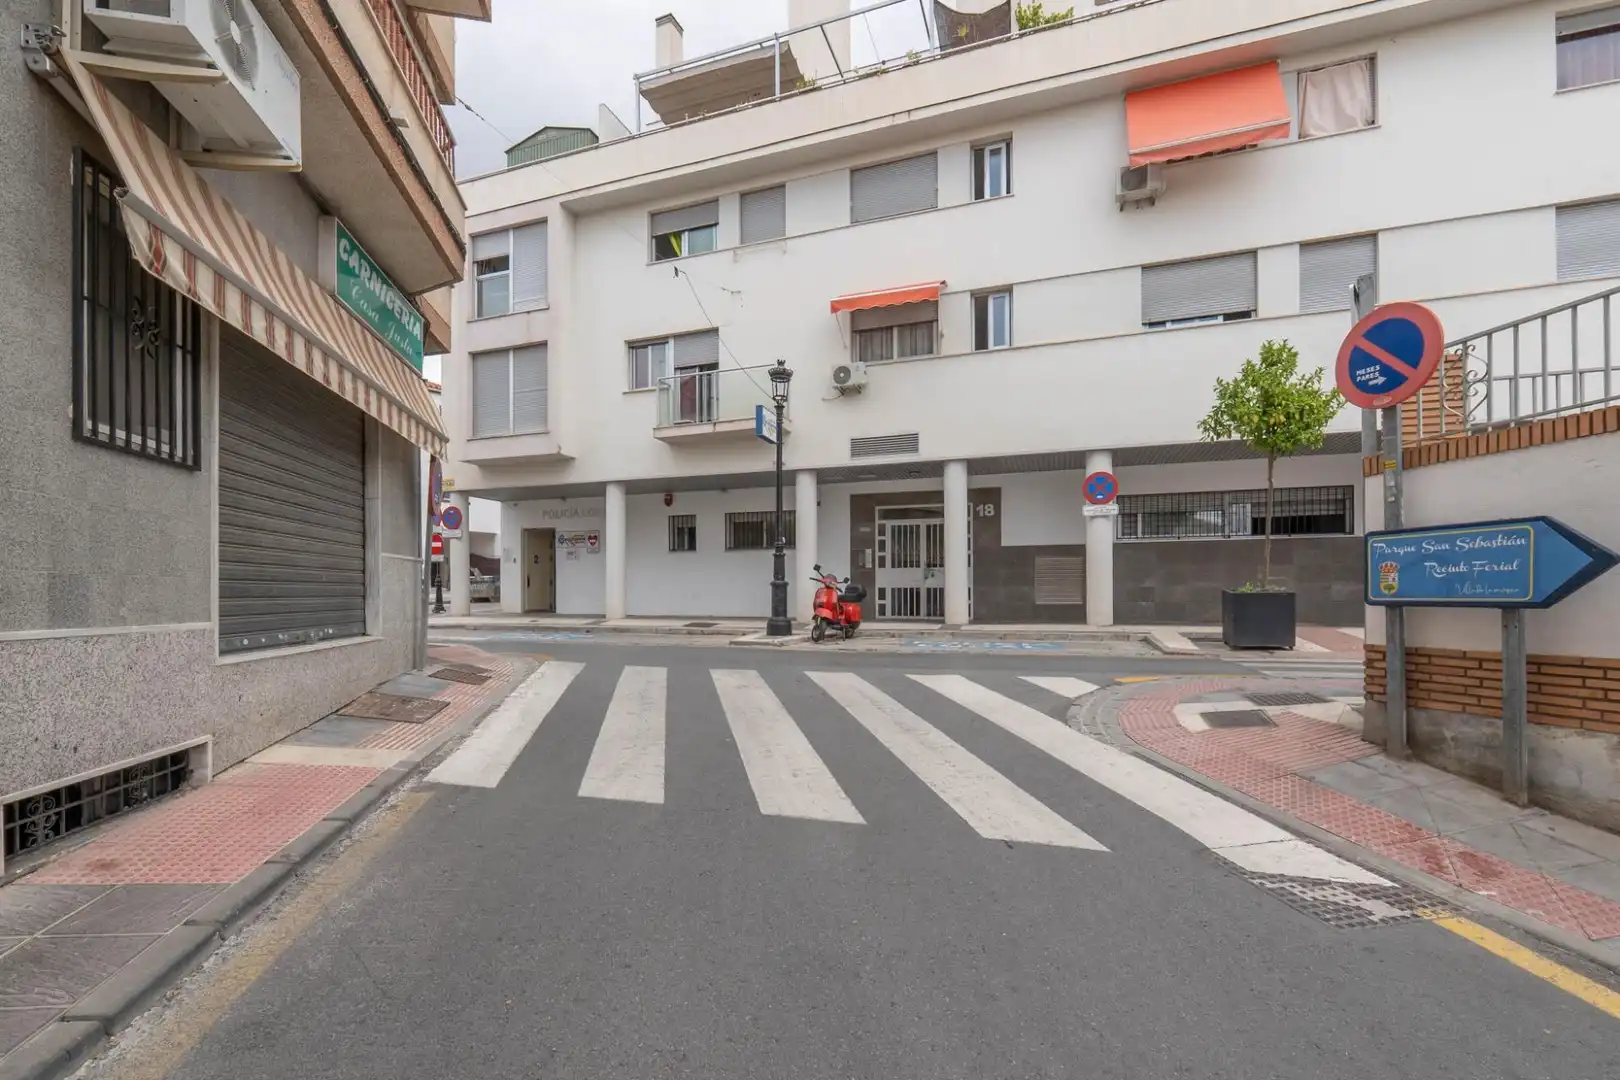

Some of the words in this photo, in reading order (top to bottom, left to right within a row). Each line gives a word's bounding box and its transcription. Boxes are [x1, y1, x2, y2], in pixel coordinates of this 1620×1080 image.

[350, 279, 379, 323] Casa
[1356, 364, 1381, 376] MESES
[1356, 371, 1380, 382] PARES
[976, 503, 995, 517] 18
[1372, 542, 1417, 559] Parque
[1421, 539, 1450, 554] San
[1455, 534, 1528, 552] Sebastián
[1423, 561, 1470, 577] Recinto
[1471, 559, 1520, 578] Ferial
